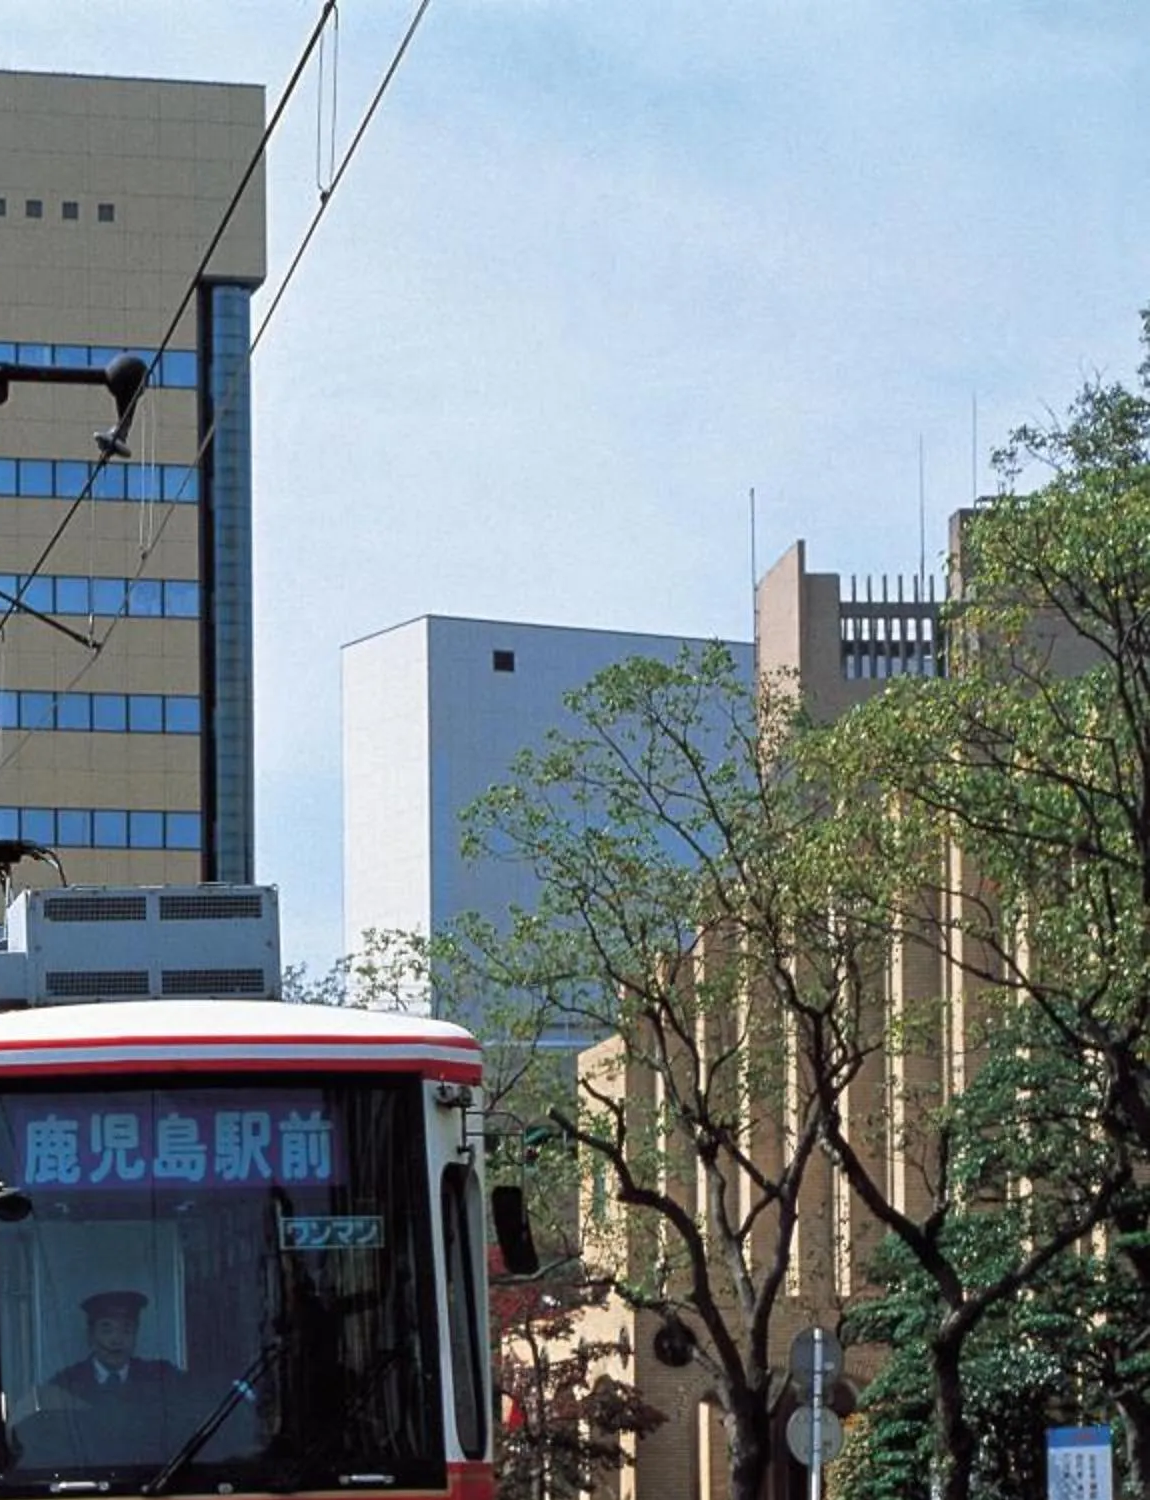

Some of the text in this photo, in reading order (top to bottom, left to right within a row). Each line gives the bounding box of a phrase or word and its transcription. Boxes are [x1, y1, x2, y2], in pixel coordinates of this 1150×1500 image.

[24, 1110, 333, 1184] 鹿児島駅前
[286, 1221, 379, 1246] ワンマン
